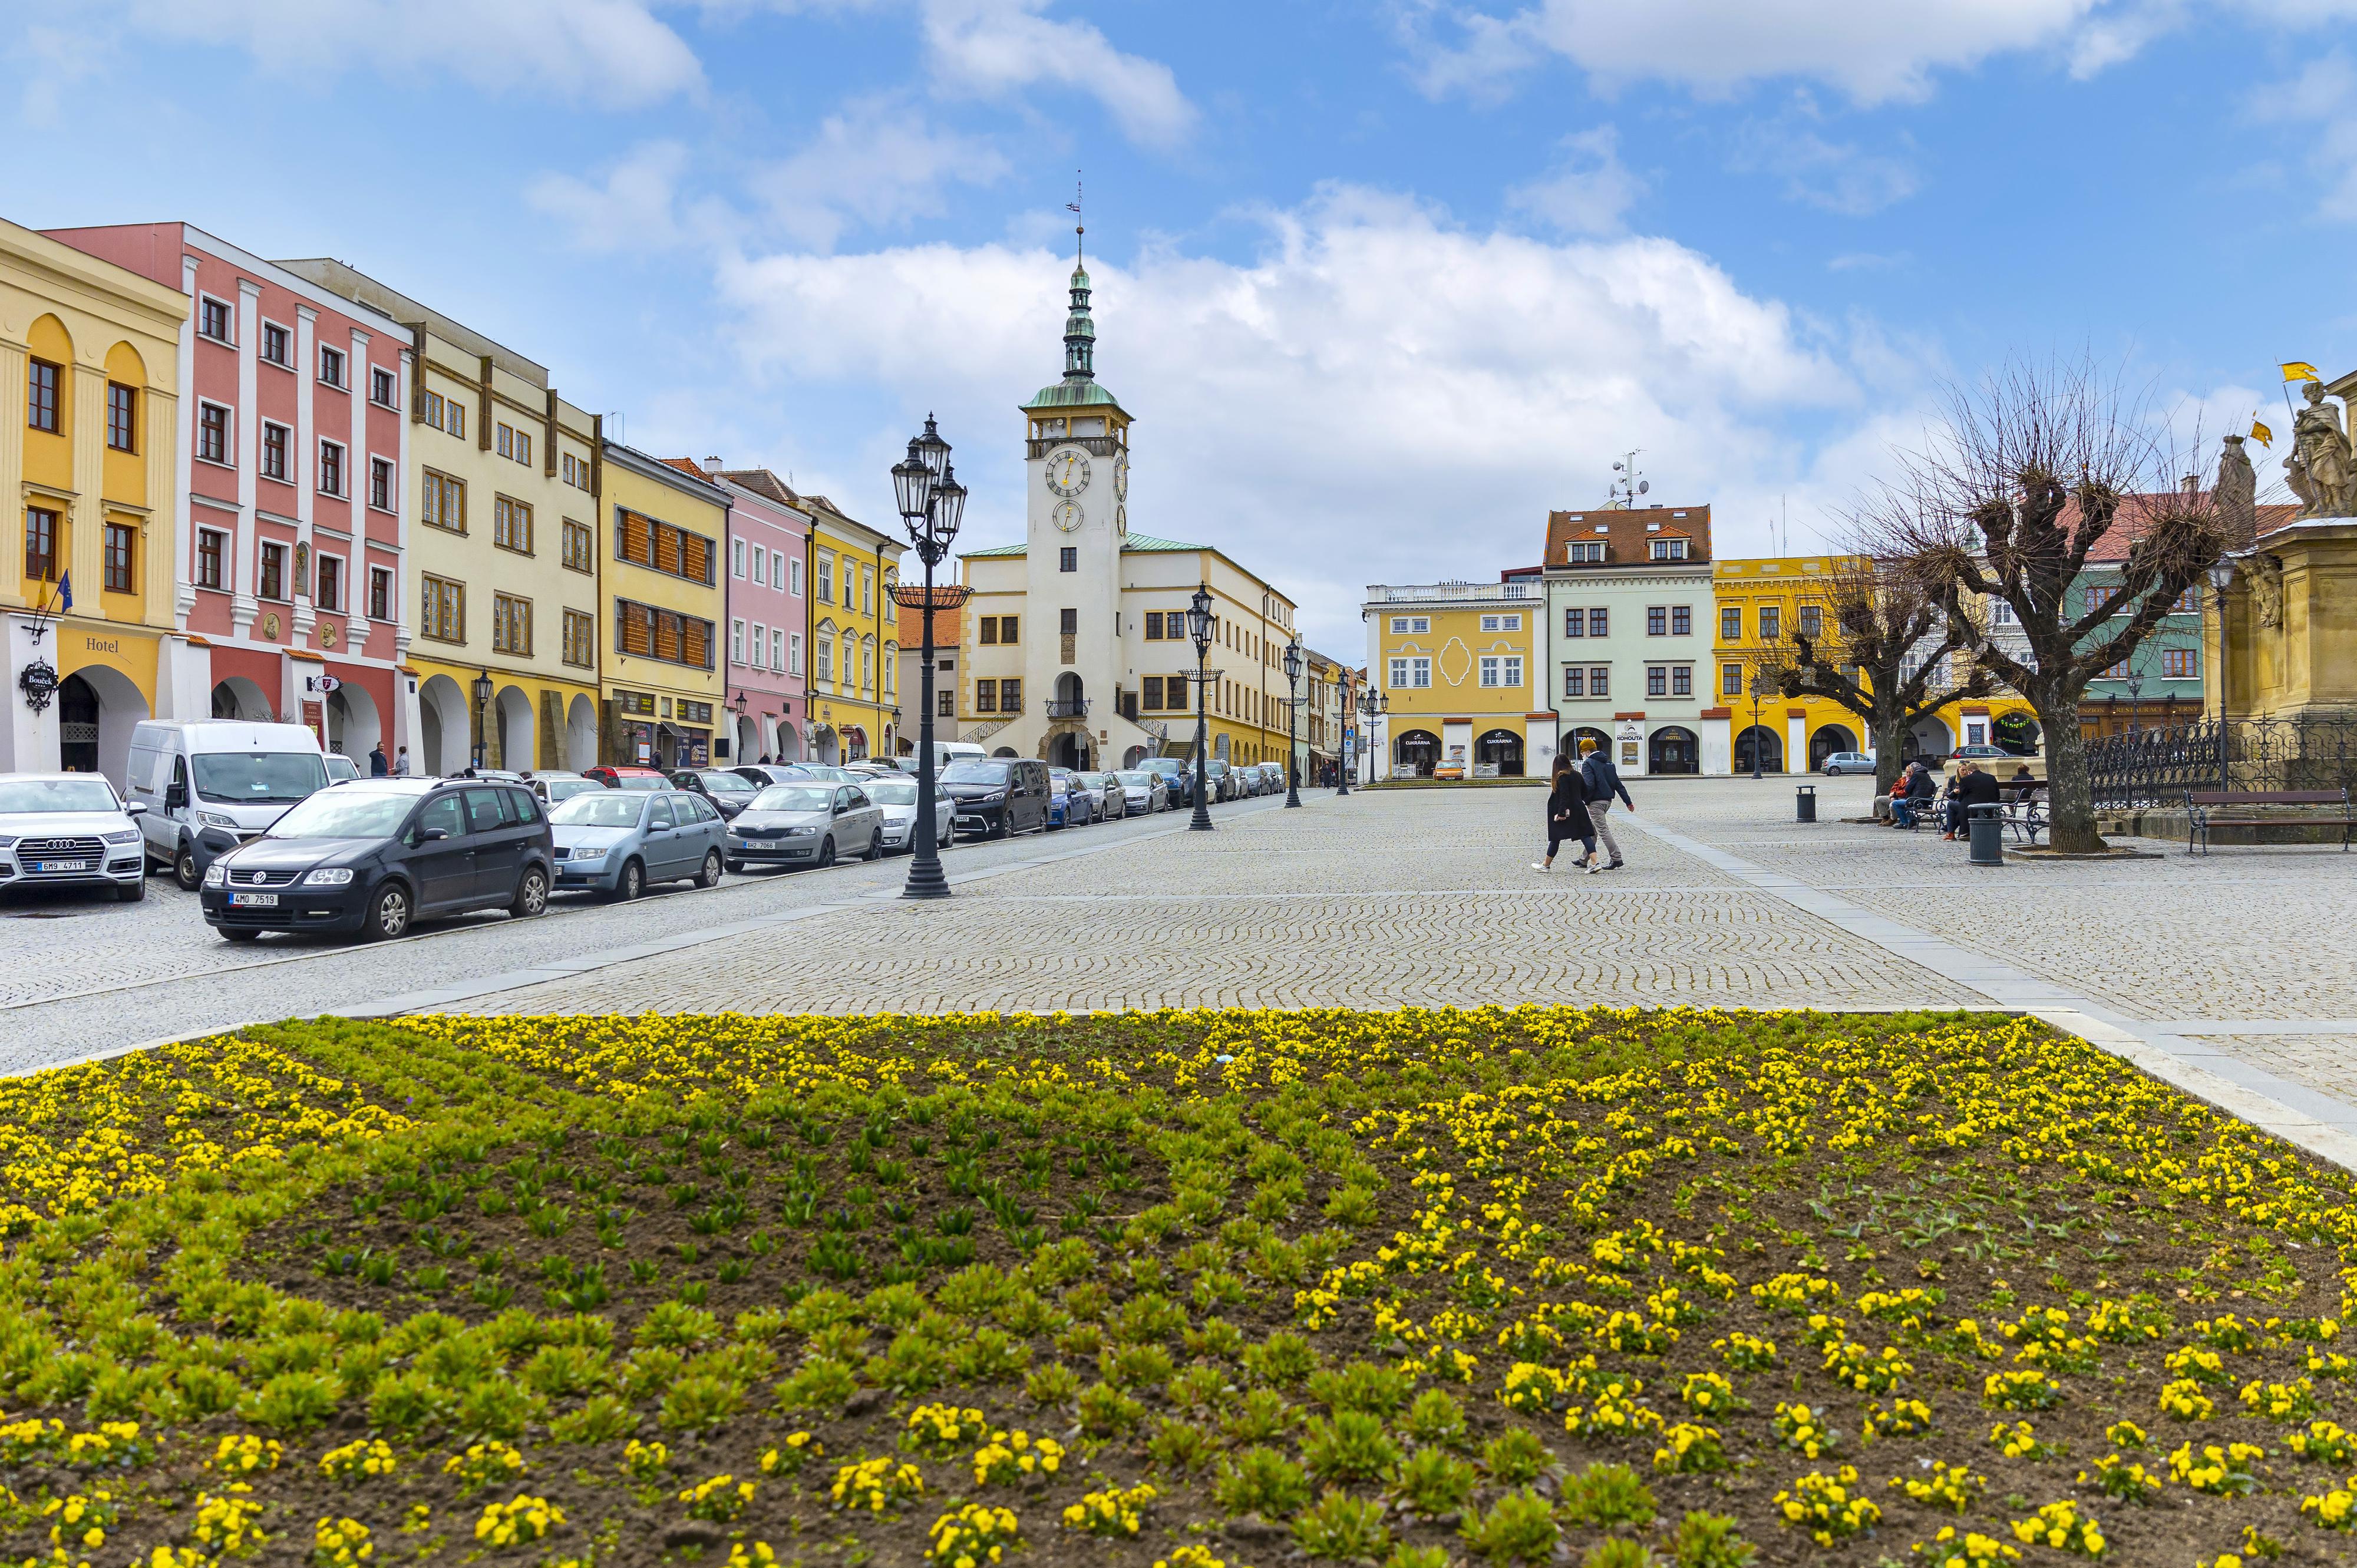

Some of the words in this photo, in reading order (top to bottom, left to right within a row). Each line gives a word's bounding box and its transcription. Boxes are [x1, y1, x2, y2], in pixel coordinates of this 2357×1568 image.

[87, 638, 118, 653] Hotel
[29, 675, 52, 685] Bouček
[236, 894, 249, 903] 4M0
[255, 895, 274, 904] 7519
